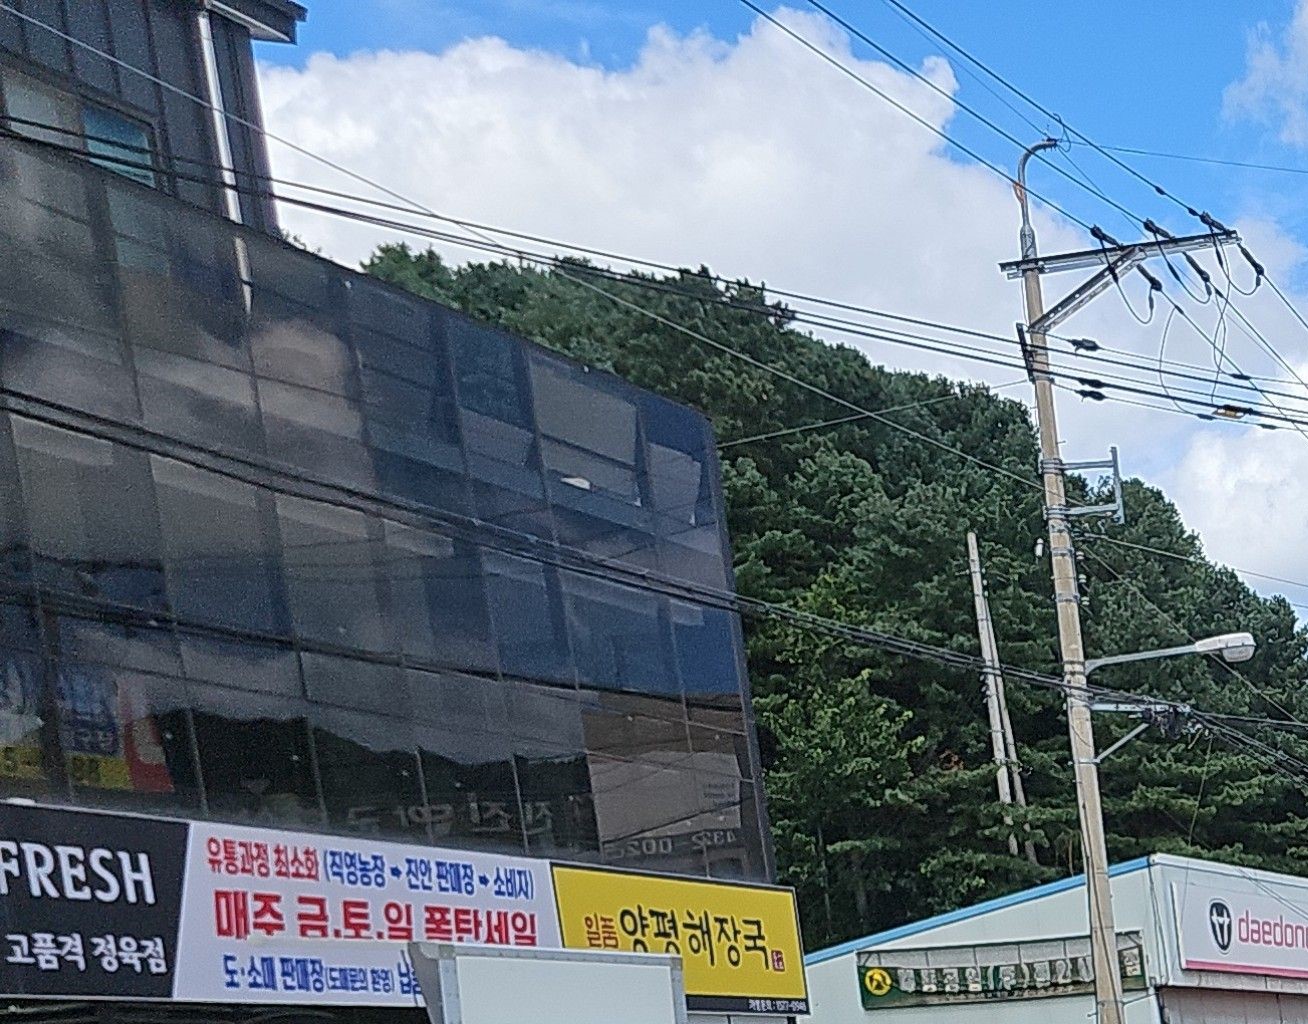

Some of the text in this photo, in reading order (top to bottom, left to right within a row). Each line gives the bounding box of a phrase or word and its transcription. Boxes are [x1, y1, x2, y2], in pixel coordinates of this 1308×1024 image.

[0, 841, 156, 905] FRESH
[207, 837, 270, 878] 유통과정
[274, 843, 320, 881] 최소화
[405, 858, 433, 890] 진안
[435, 861, 475, 895] 판매장
[493, 867, 534, 900] 소비자)
[213, 889, 286, 940] 매주
[584, 903, 771, 971] 일품 양평해장국
[5, 932, 168, 975] 고품격 정육점
